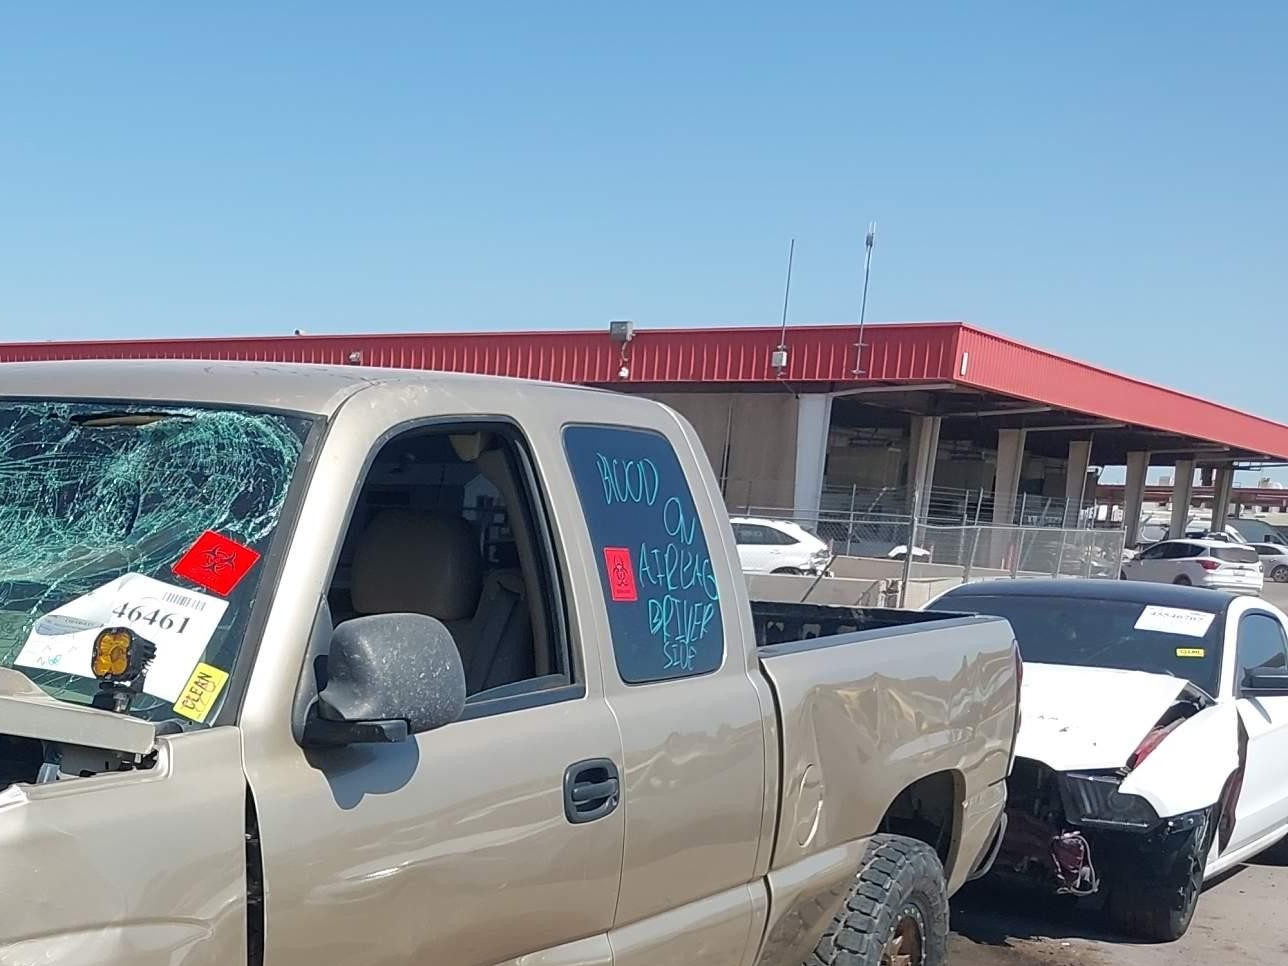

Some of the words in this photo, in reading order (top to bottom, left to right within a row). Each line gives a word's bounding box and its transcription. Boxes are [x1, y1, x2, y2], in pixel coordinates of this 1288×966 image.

[597, 452, 659, 506] BLOOD
[664, 497, 695, 545] ON
[639, 543, 720, 601] AIRBAG
[648, 594, 714, 643] DRIVER
[663, 639, 697, 671] SIDE
[181, 671, 214, 710] CLEAN
